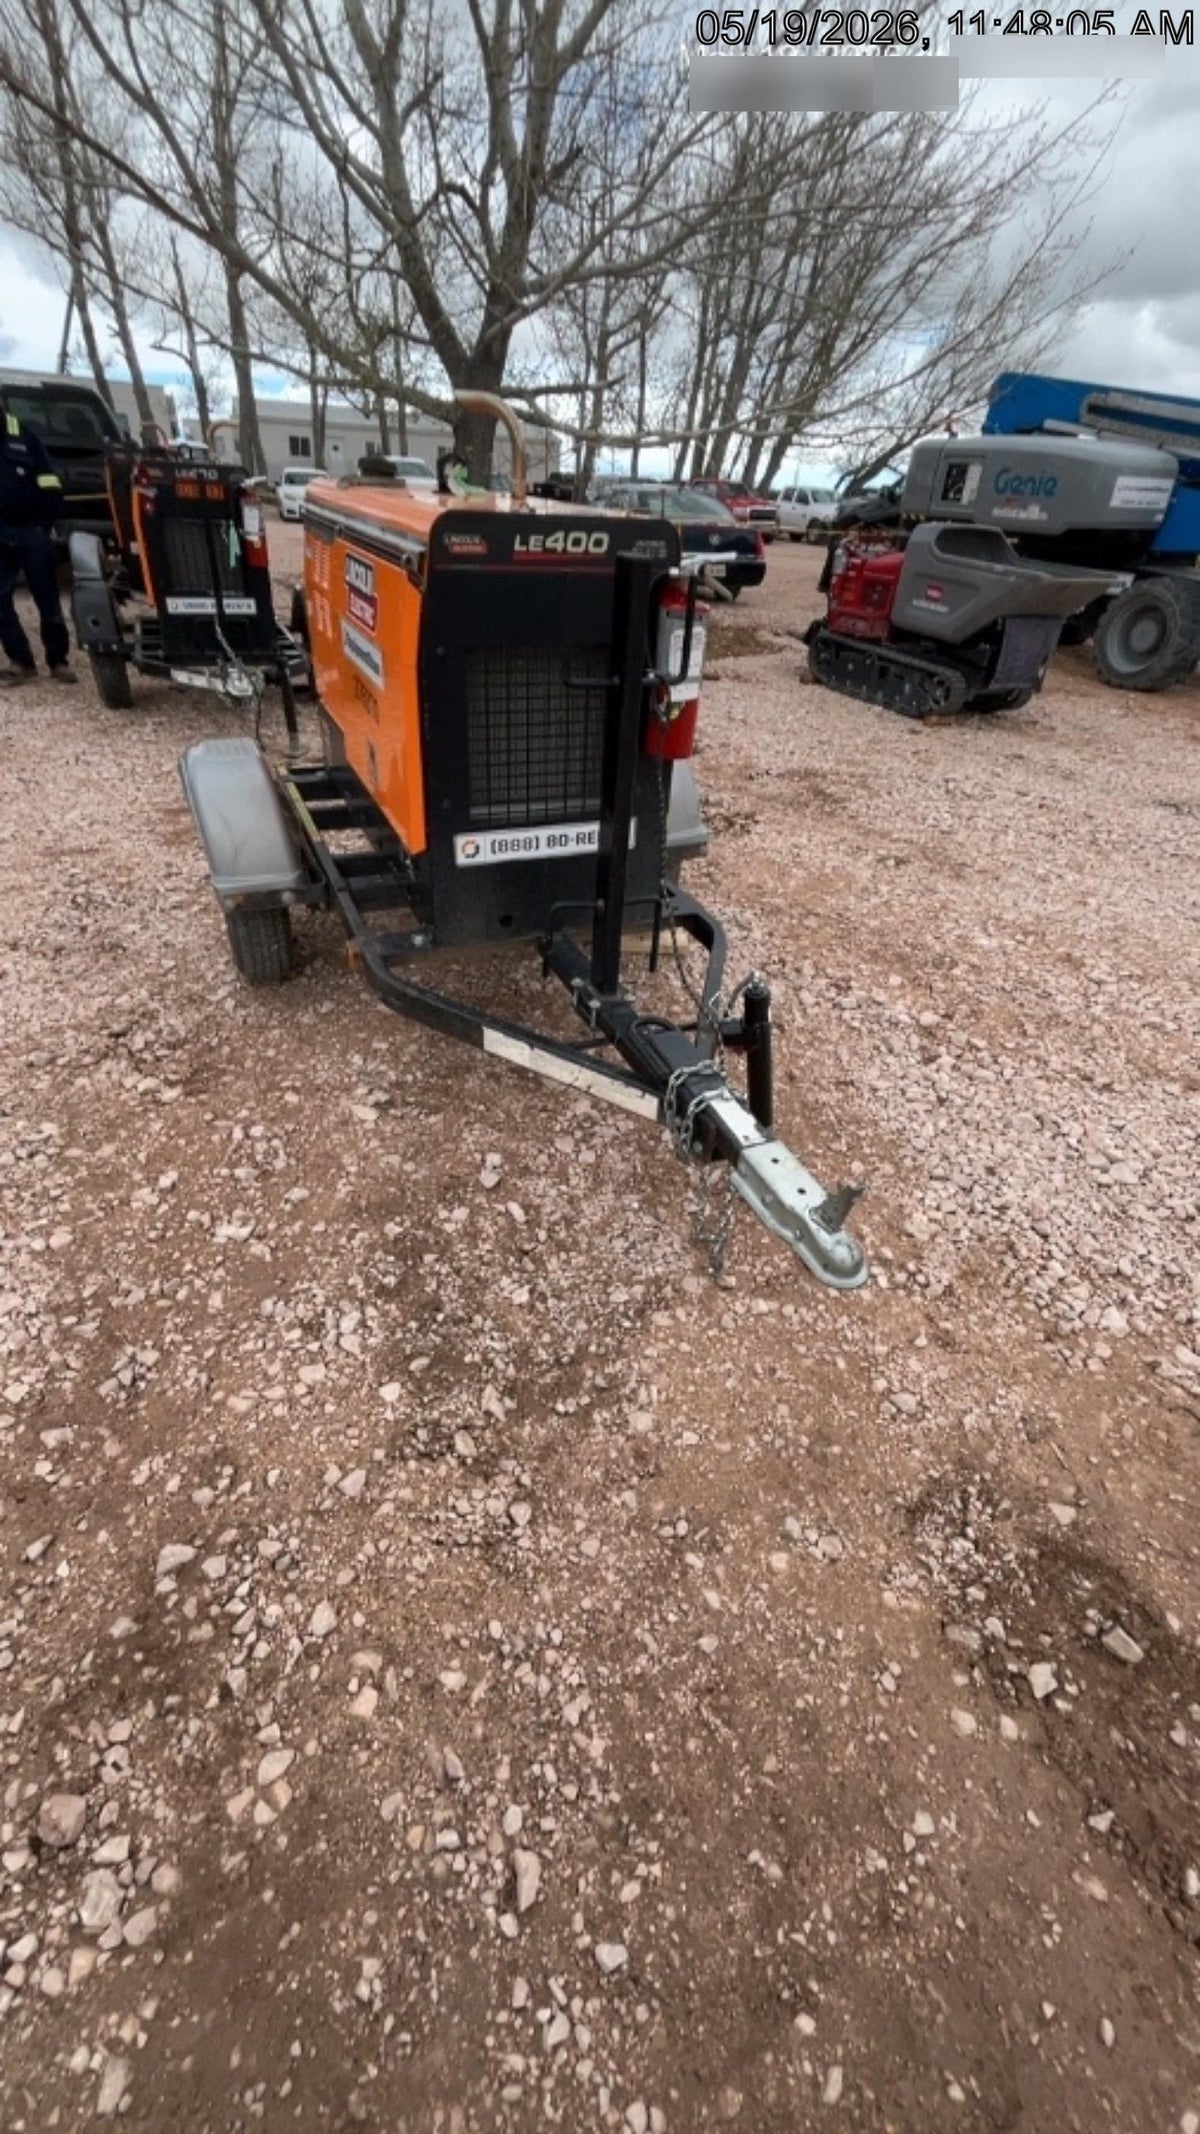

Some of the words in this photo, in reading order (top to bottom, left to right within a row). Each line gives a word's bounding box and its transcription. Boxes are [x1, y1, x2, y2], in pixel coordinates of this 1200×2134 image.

[993, 467, 1058, 497] Genie
[514, 530, 610, 553] LE400
[490, 834, 540, 855] (888)
[547, 830, 600, 848] 80-RE
